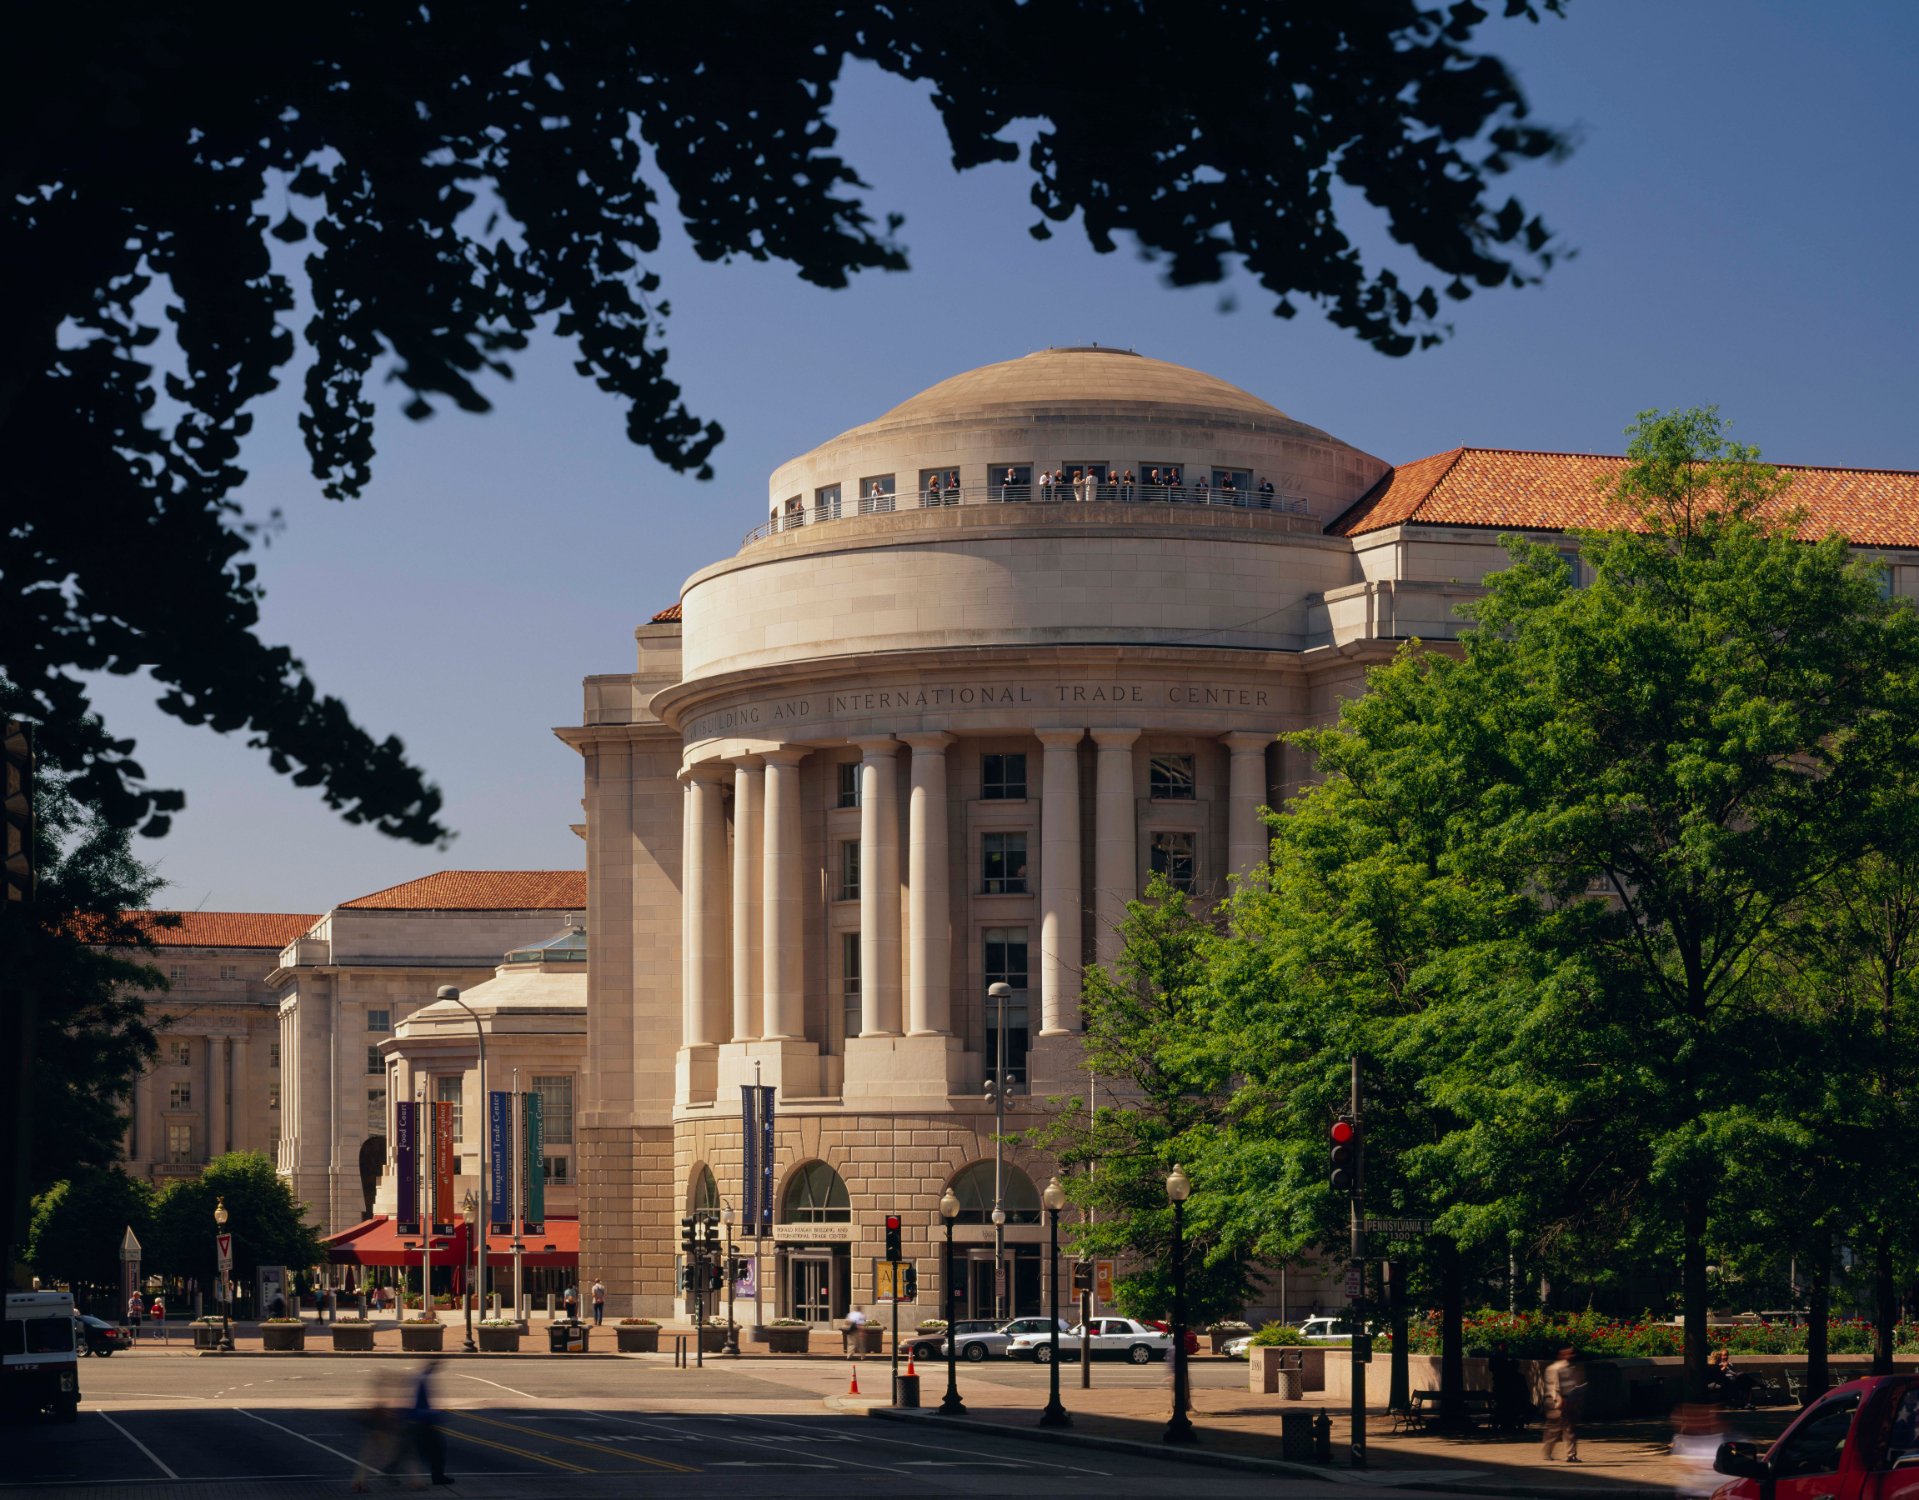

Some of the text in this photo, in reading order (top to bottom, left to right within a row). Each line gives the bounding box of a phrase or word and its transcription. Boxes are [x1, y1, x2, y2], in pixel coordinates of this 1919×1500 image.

[701, 706, 760, 736] BUILDING
[774, 700, 810, 720] AND
[827, 686, 1032, 713] INTERNATIONAL
[1055, 686, 1144, 702] TRADE
[1168, 687, 1269, 706] CENTER
[399, 1104, 407, 1148] Food Court
[535, 1091, 544, 1167] Conference Center
[493, 1151, 501, 1204] International
[1368, 1220, 1422, 1232] PENNSYLVANIA
[1390, 1232, 1410, 1240] 1300
